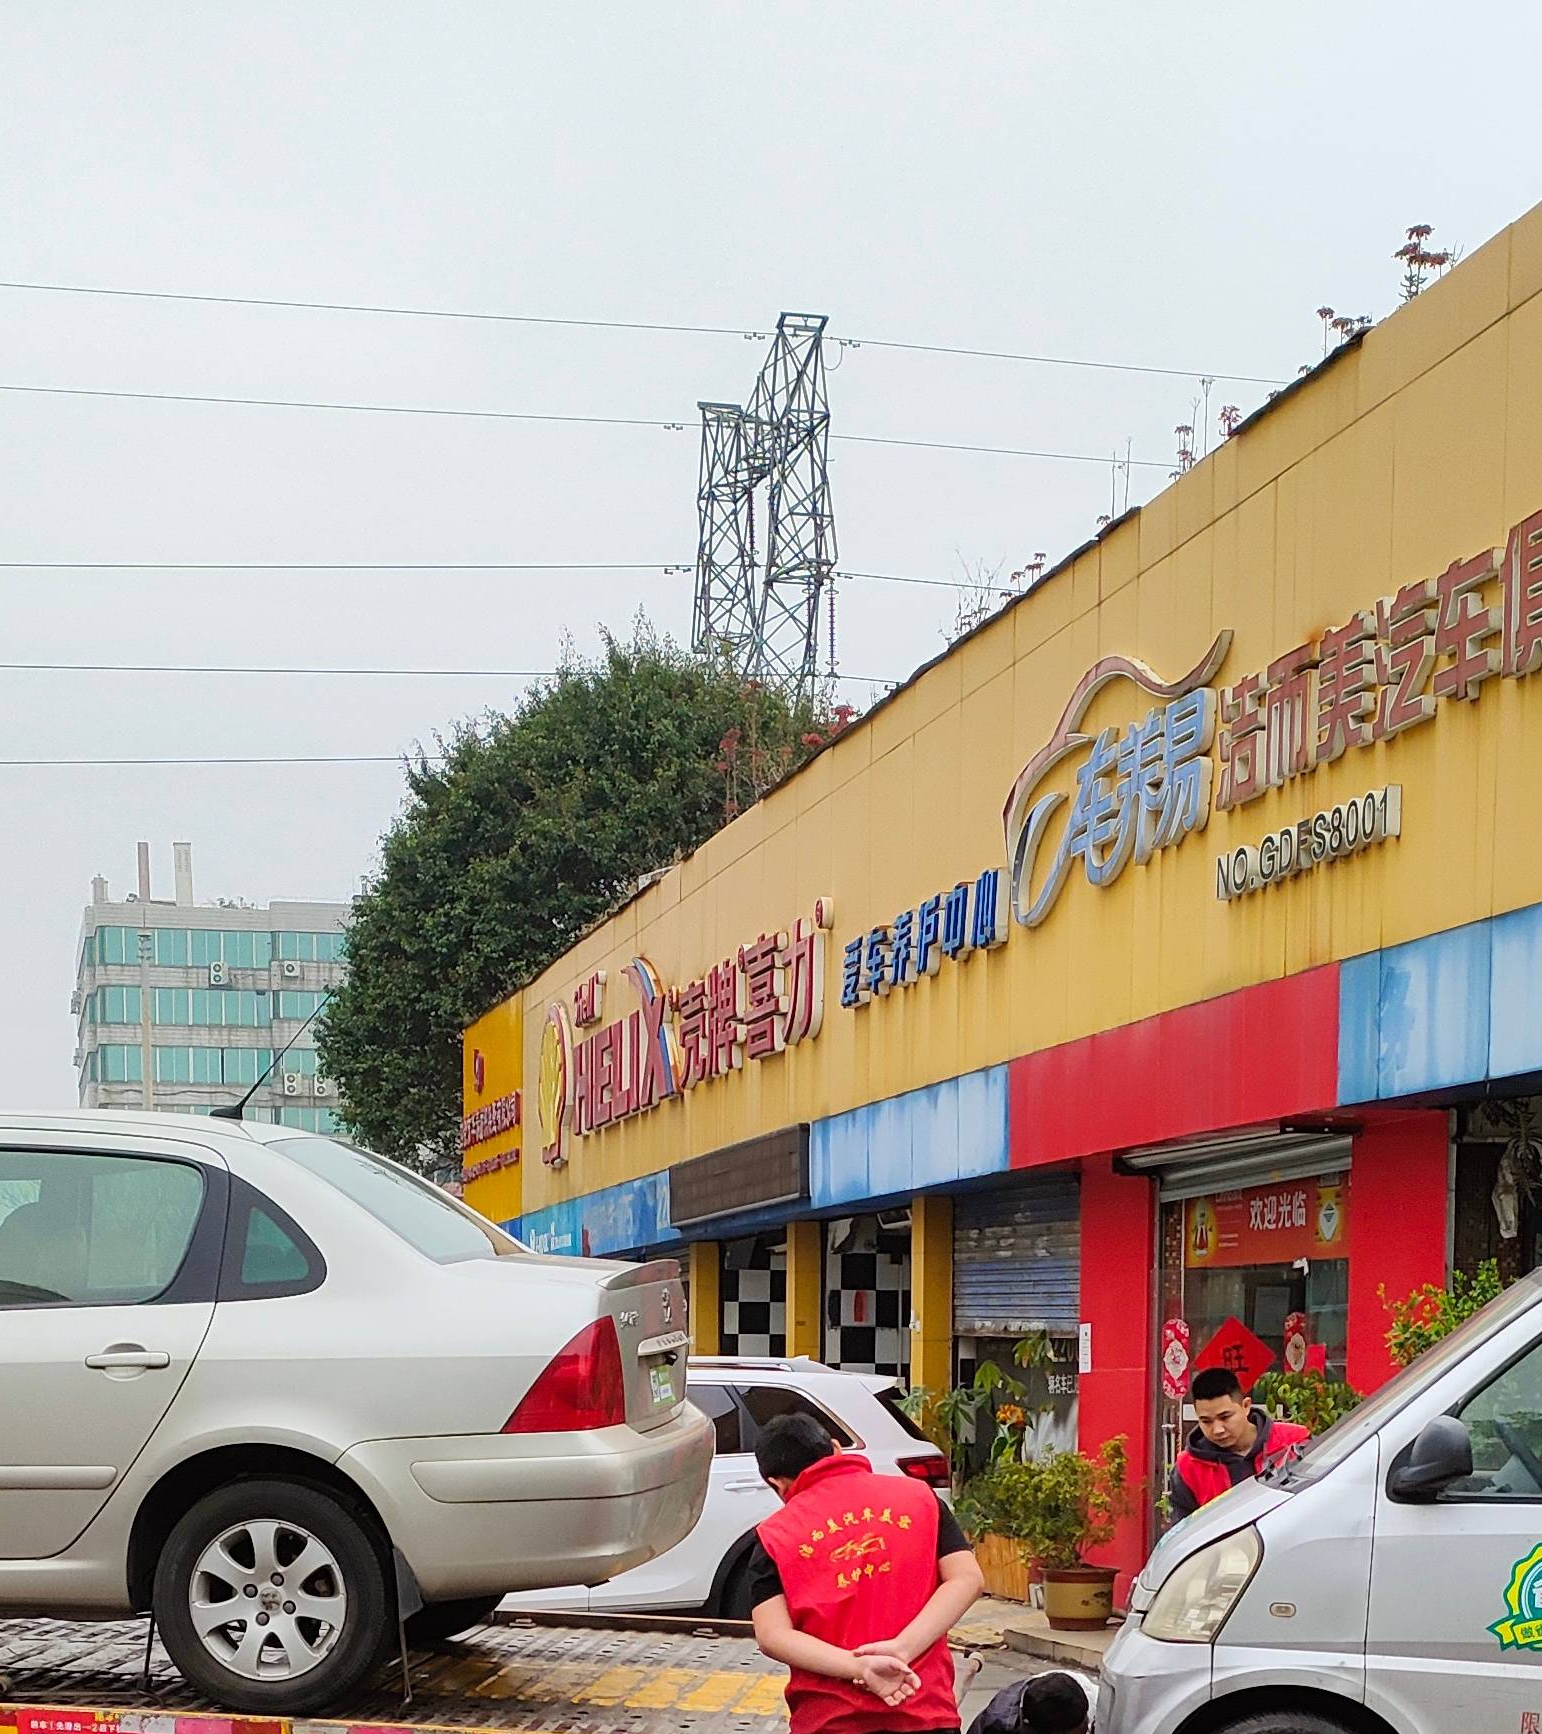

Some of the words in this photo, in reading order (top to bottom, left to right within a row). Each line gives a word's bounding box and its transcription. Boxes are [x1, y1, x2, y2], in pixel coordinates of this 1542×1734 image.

[840, 868, 1004, 1009] 爱车养护中心
[572, 956, 681, 1137] HELIX
[1249, 1190, 1308, 1231] 欢迎光临
